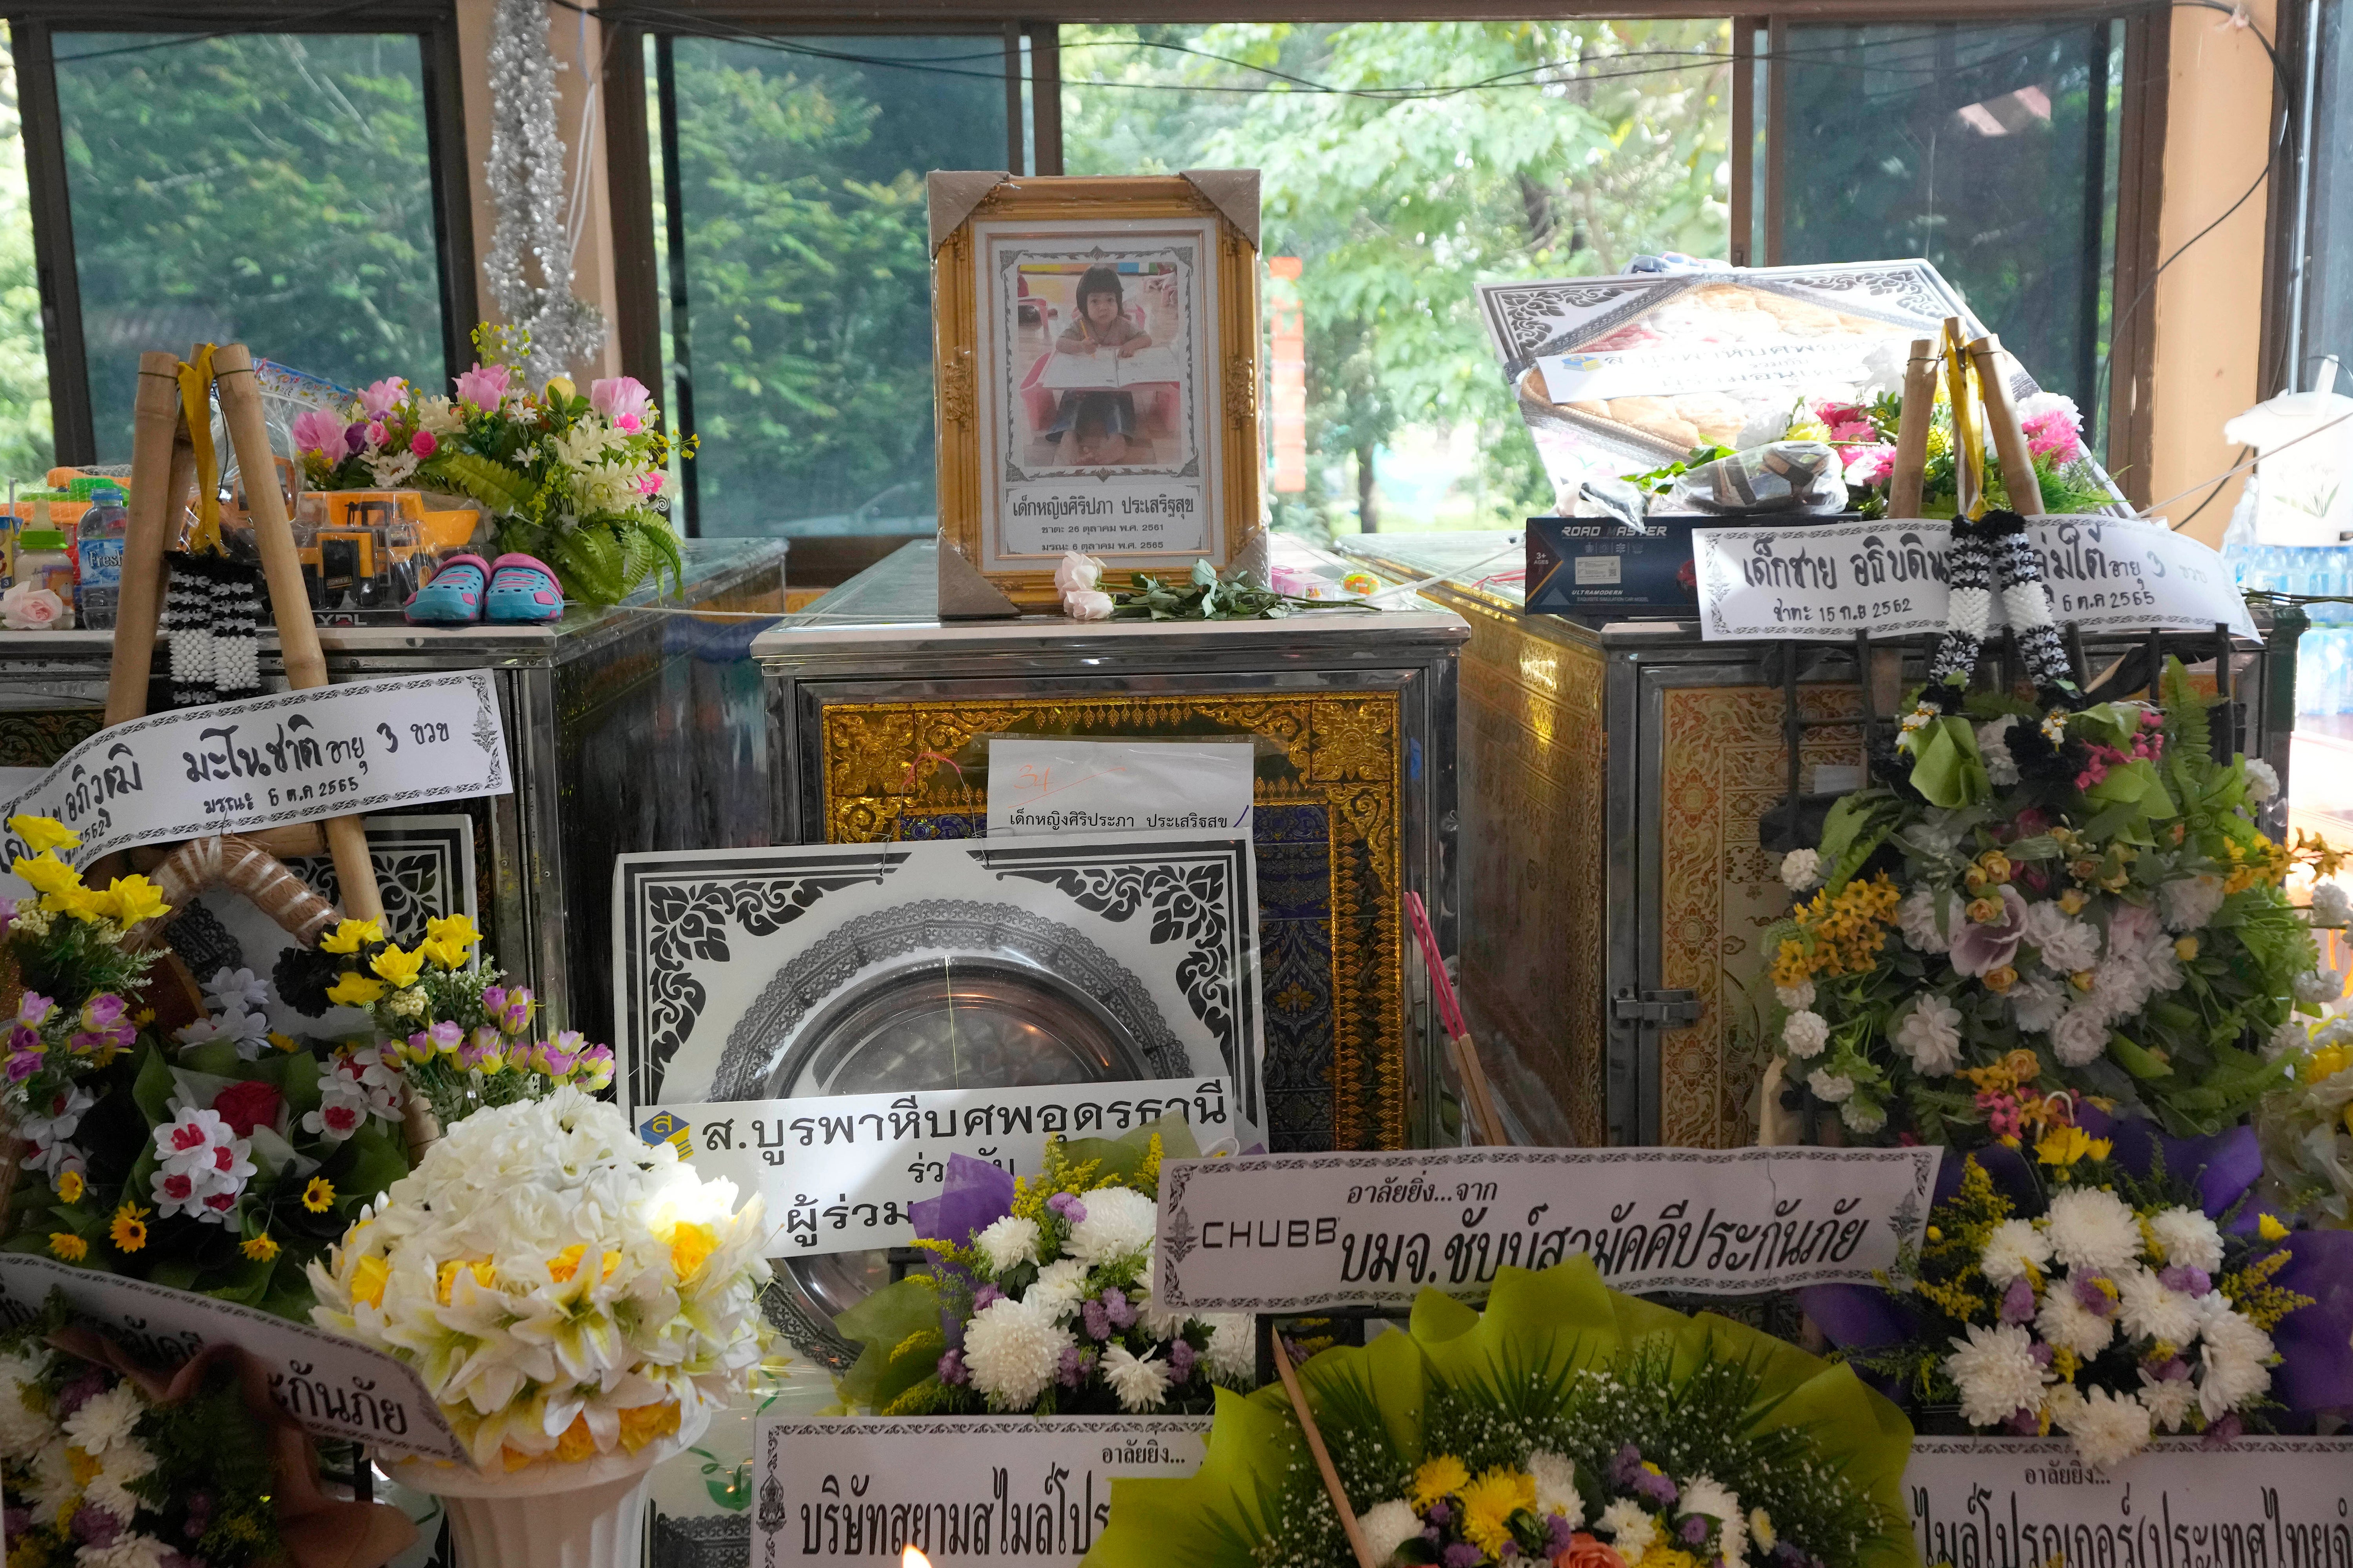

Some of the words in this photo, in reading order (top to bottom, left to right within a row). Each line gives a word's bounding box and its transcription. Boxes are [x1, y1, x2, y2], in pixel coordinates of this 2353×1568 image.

[1013, 494, 1113, 520] เด็กหญิงศิริปภา
[1122, 493, 1194, 520] ประเสริฐสุข
[1083, 525, 1116, 535] ตุลาคม
[1562, 526, 1601, 537] ROAD
[1081, 543, 1115, 553] ตุลาคม
[1743, 537, 1838, 589] เด็กชาย
[1849, 532, 1952, 586] อธิบดิน
[2109, 560, 2146, 590] อายุ
[2147, 550, 2166, 578] 3
[1819, 607, 1836, 622] 15
[1873, 598, 1913, 618] 2562
[2063, 594, 2072, 612] 6
[2110, 591, 2155, 609] 2565
[326, 737, 369, 776] อายุ
[376, 722, 398, 753] 3
[1010, 807, 1134, 830] เด็กหญิงศิริประภา
[702, 1079, 1227, 1166] ส.บูรพาหีบศพอุดรธานี
[1202, 1217, 1337, 1248] CHUBB
